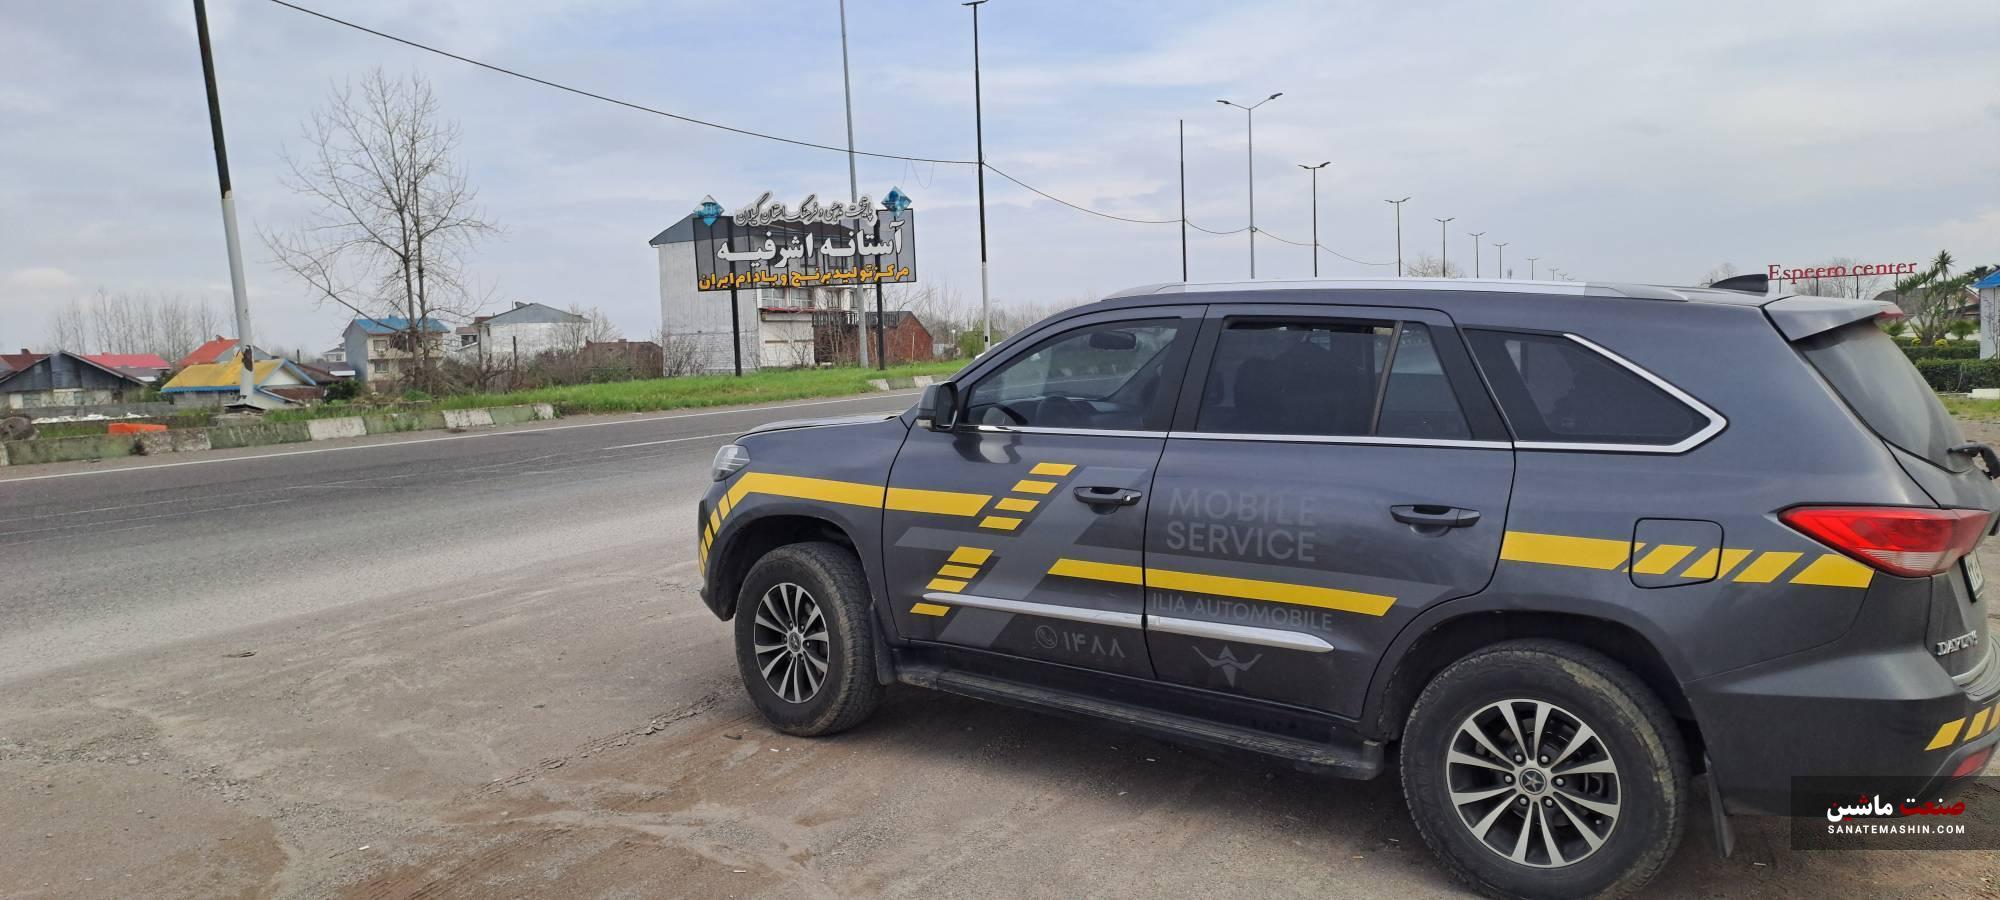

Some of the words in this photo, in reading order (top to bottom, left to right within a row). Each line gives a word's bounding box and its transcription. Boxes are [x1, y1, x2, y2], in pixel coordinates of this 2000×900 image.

[735, 192, 770, 225] گیلان
[716, 230, 814, 268] اشرفیه
[820, 219, 905, 257] آستانه
[699, 271, 735, 290] ایران
[735, 269, 778, 288] بادام
[780, 272, 788, 287] و
[791, 266, 832, 288] برنج
[831, 263, 874, 284] تولید
[868, 263, 909, 282] مرکز
[1768, 264, 1847, 284] Espeero
[1852, 262, 1917, 276] center
[1167, 487, 1316, 527] MOBILE
[1166, 521, 1316, 562] SERVICE
[1152, 592, 1187, 614] ILIA
[1190, 597, 1333, 632] AUTOMOBILE
[1063, 631, 1125, 658] ۱۴۸۸
